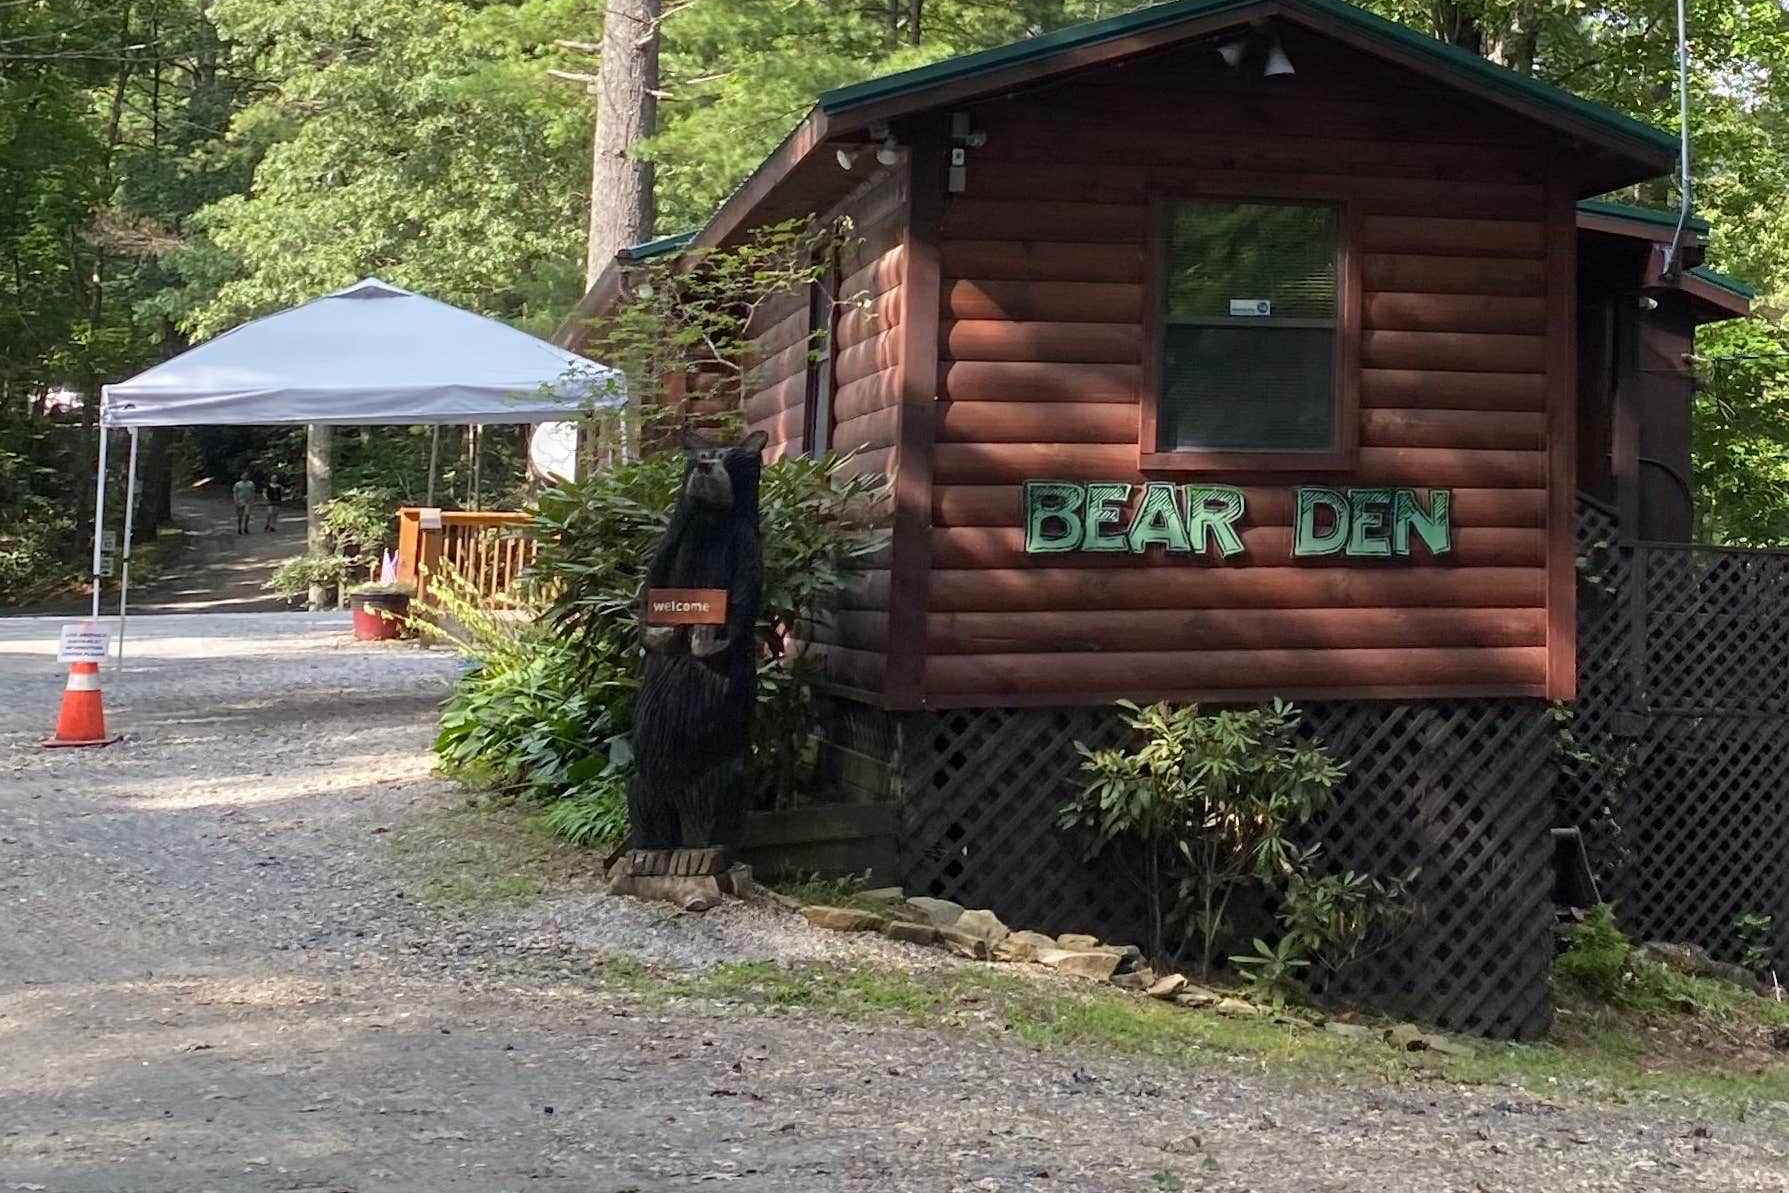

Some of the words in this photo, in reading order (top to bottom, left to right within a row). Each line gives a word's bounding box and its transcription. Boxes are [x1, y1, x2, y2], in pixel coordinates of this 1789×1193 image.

[1024, 480, 1246, 558] BEAR
[1291, 485, 1452, 558] DEN
[653, 600, 710, 612] welcome
